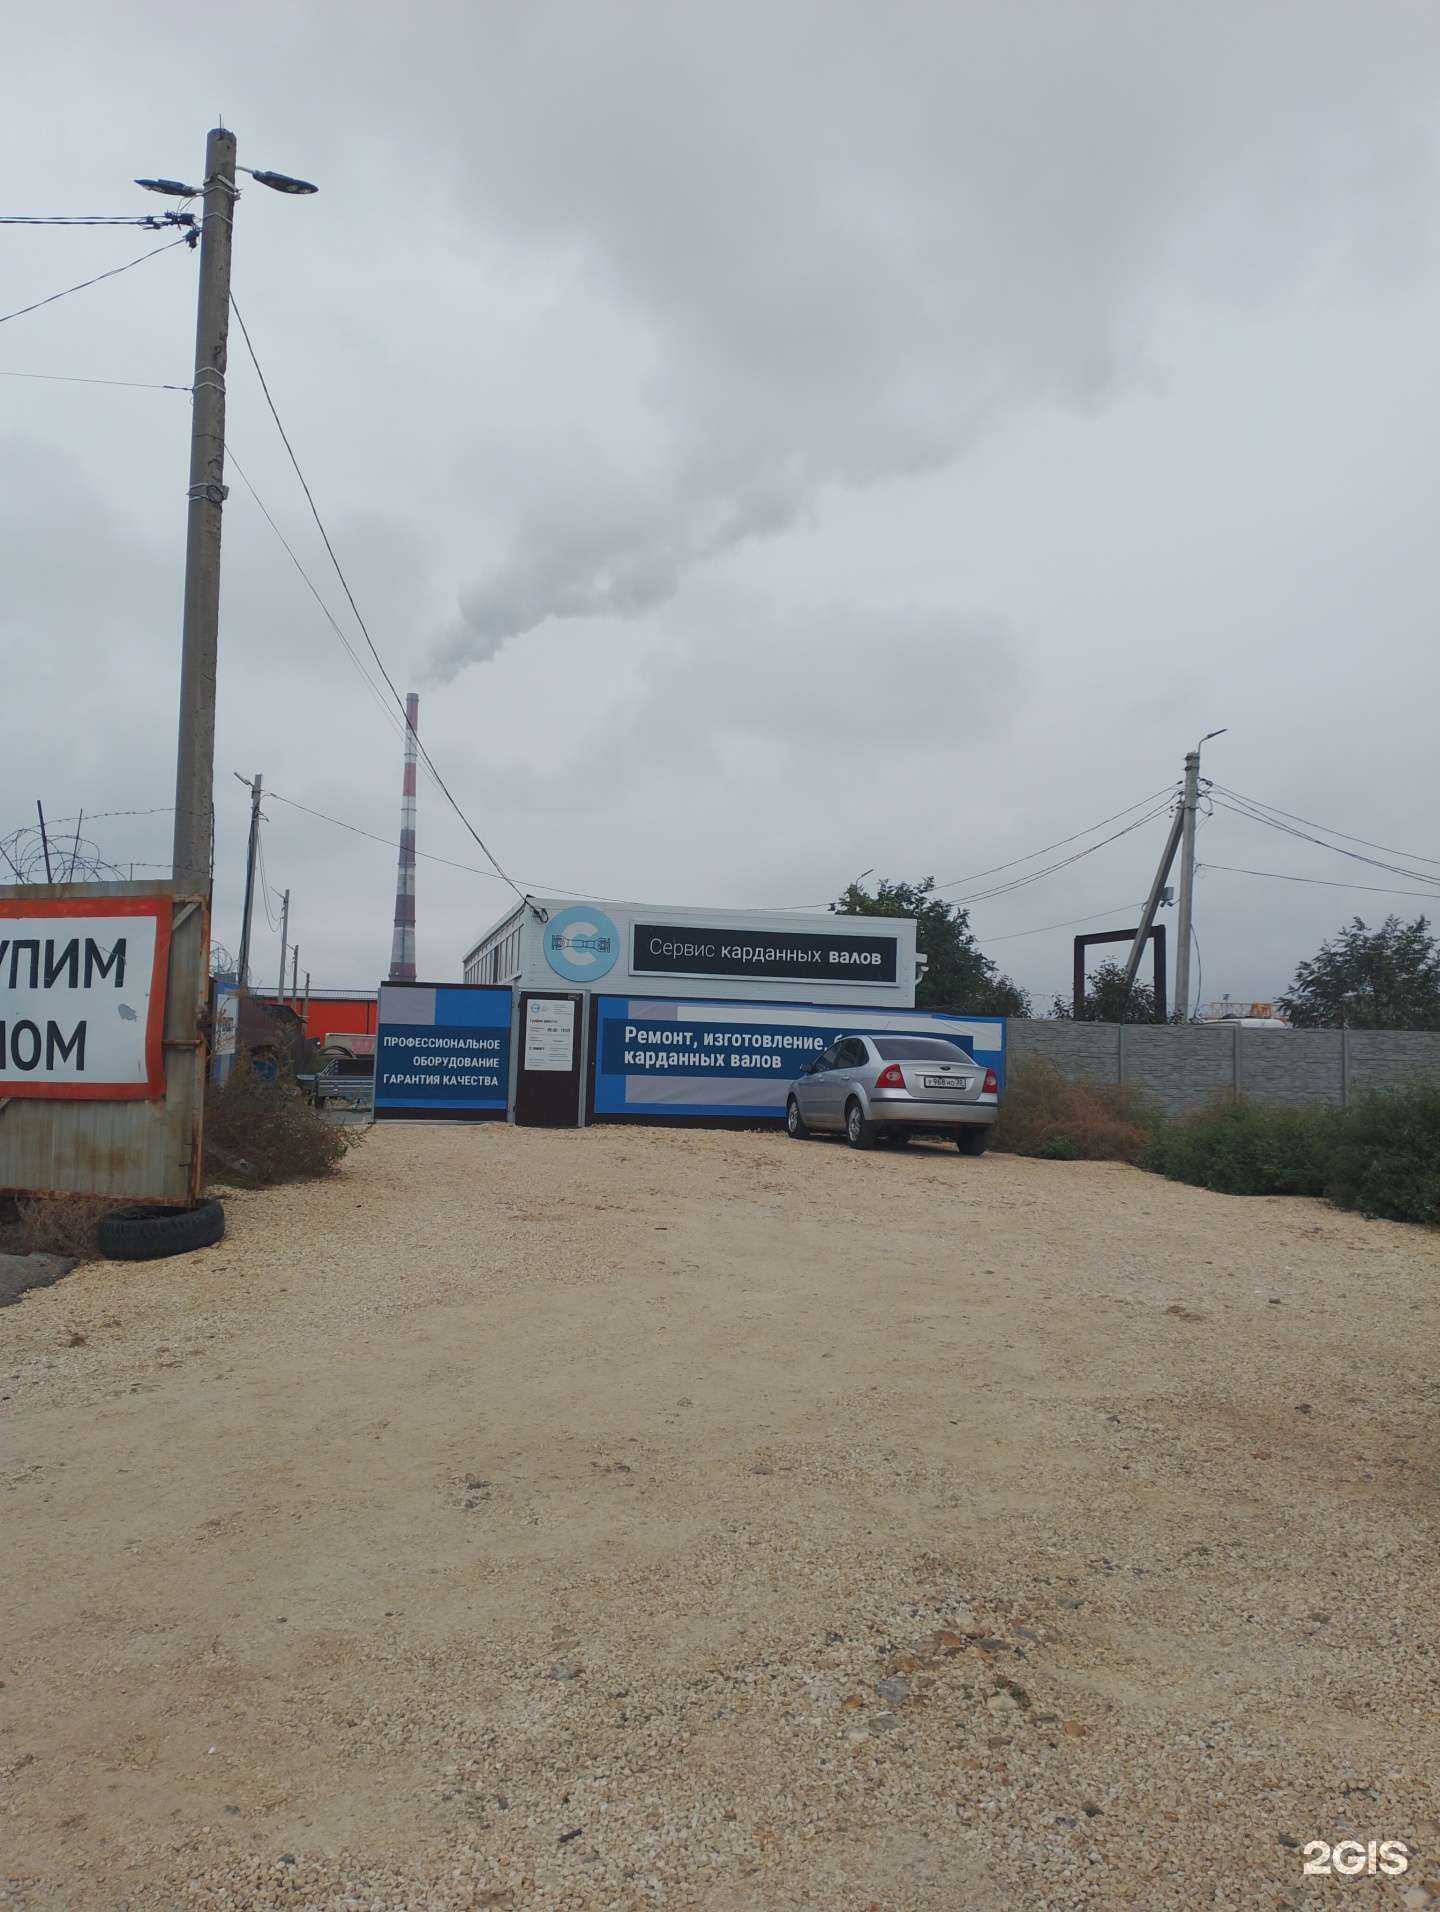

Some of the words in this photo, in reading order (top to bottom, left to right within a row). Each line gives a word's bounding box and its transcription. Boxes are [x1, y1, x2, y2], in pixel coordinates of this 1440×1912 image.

[649, 938, 715, 959] Сервис
[721, 945, 821, 963] карданных
[829, 951, 882, 965] валов
[0, 938, 127, 988] ПИМ
[383, 1036, 501, 1050] ПРОФЕССИОНАЛЬНОЕ
[625, 1026, 698, 1049] Ремонт,
[703, 1032, 828, 1051] изготовление,
[413, 1056, 499, 1068] ОБОРУДОВАНИЕ
[624, 1050, 725, 1069] карданных
[730, 1054, 782, 1069] валов
[383, 1074, 440, 1085] ГАРАНТИЯ
[443, 1075, 499, 1086] КАЧЕСТВА
